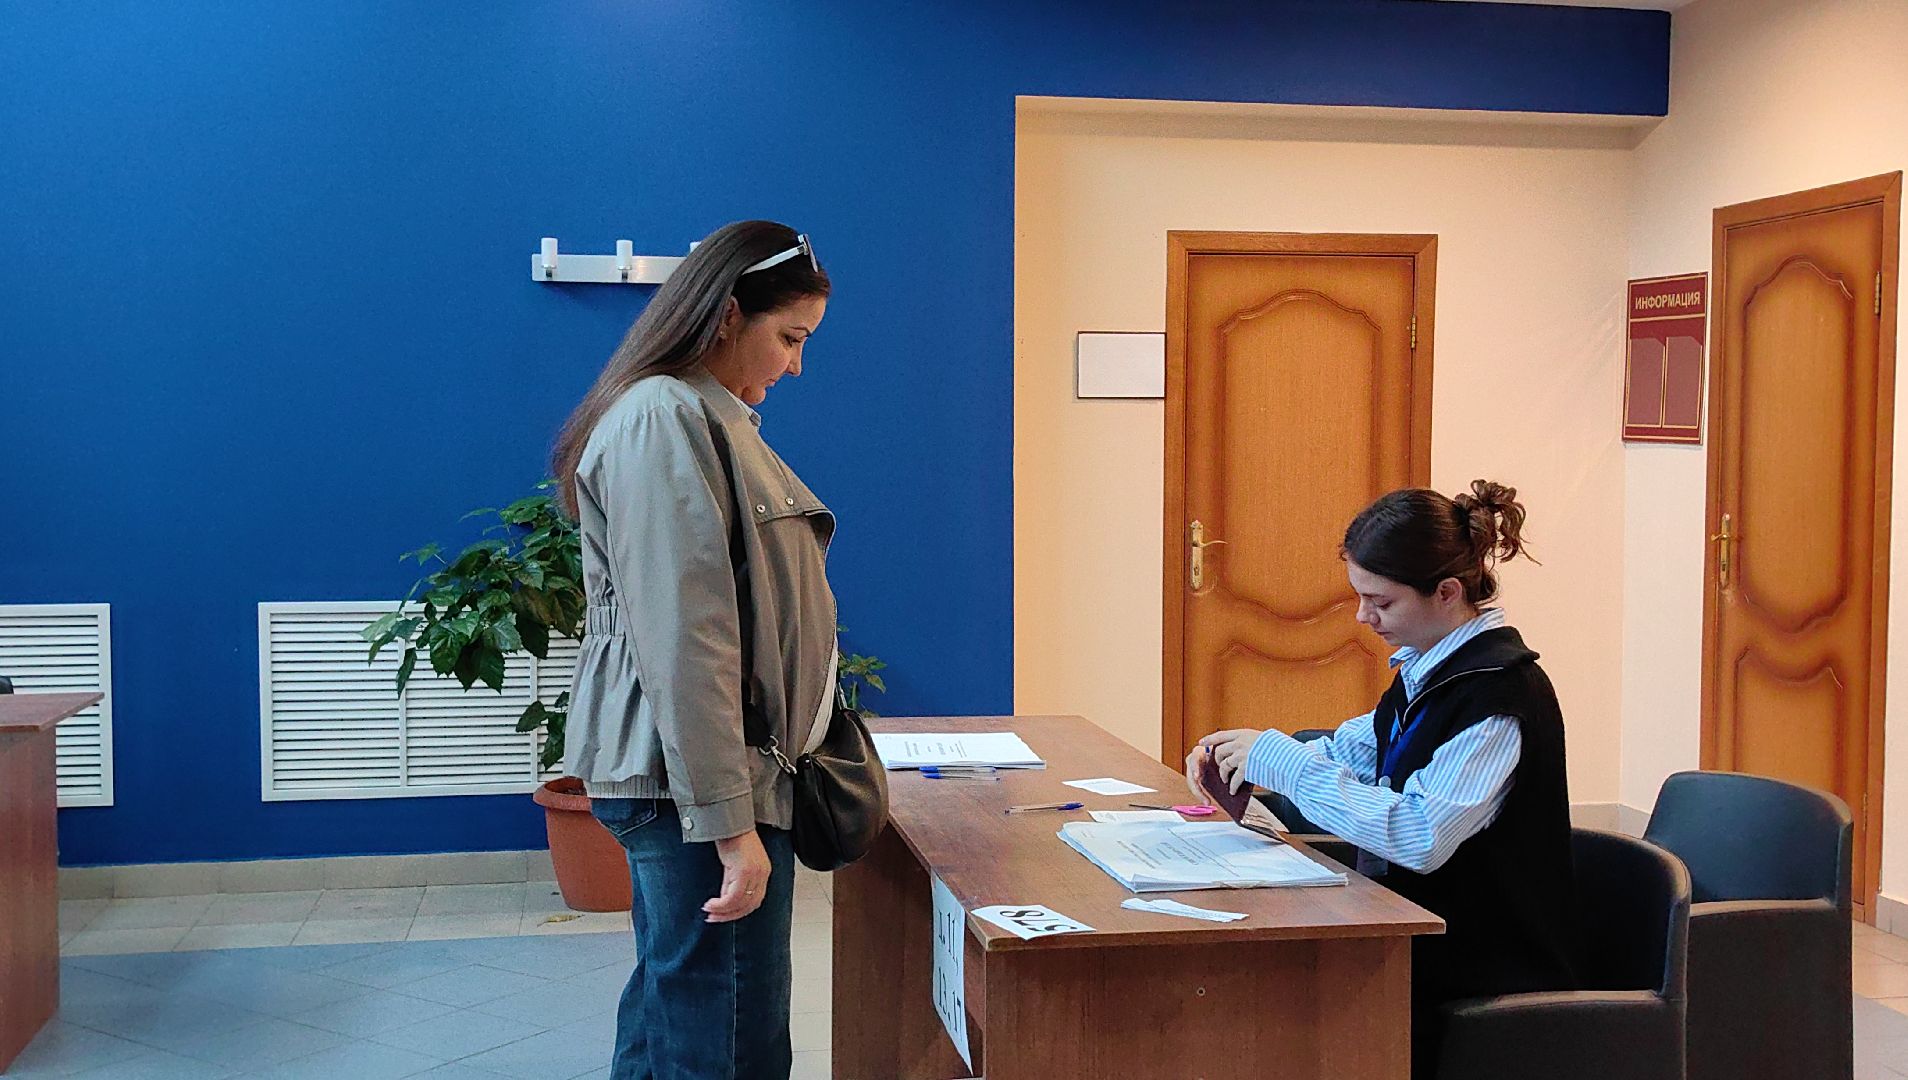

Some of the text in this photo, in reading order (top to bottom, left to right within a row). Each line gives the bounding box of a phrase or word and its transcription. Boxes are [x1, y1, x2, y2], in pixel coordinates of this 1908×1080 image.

[1635, 291, 1700, 310] ИНФОРМАЦИЯ
[999, 910, 1078, 932] 578
[952, 990, 963, 1042] 17
